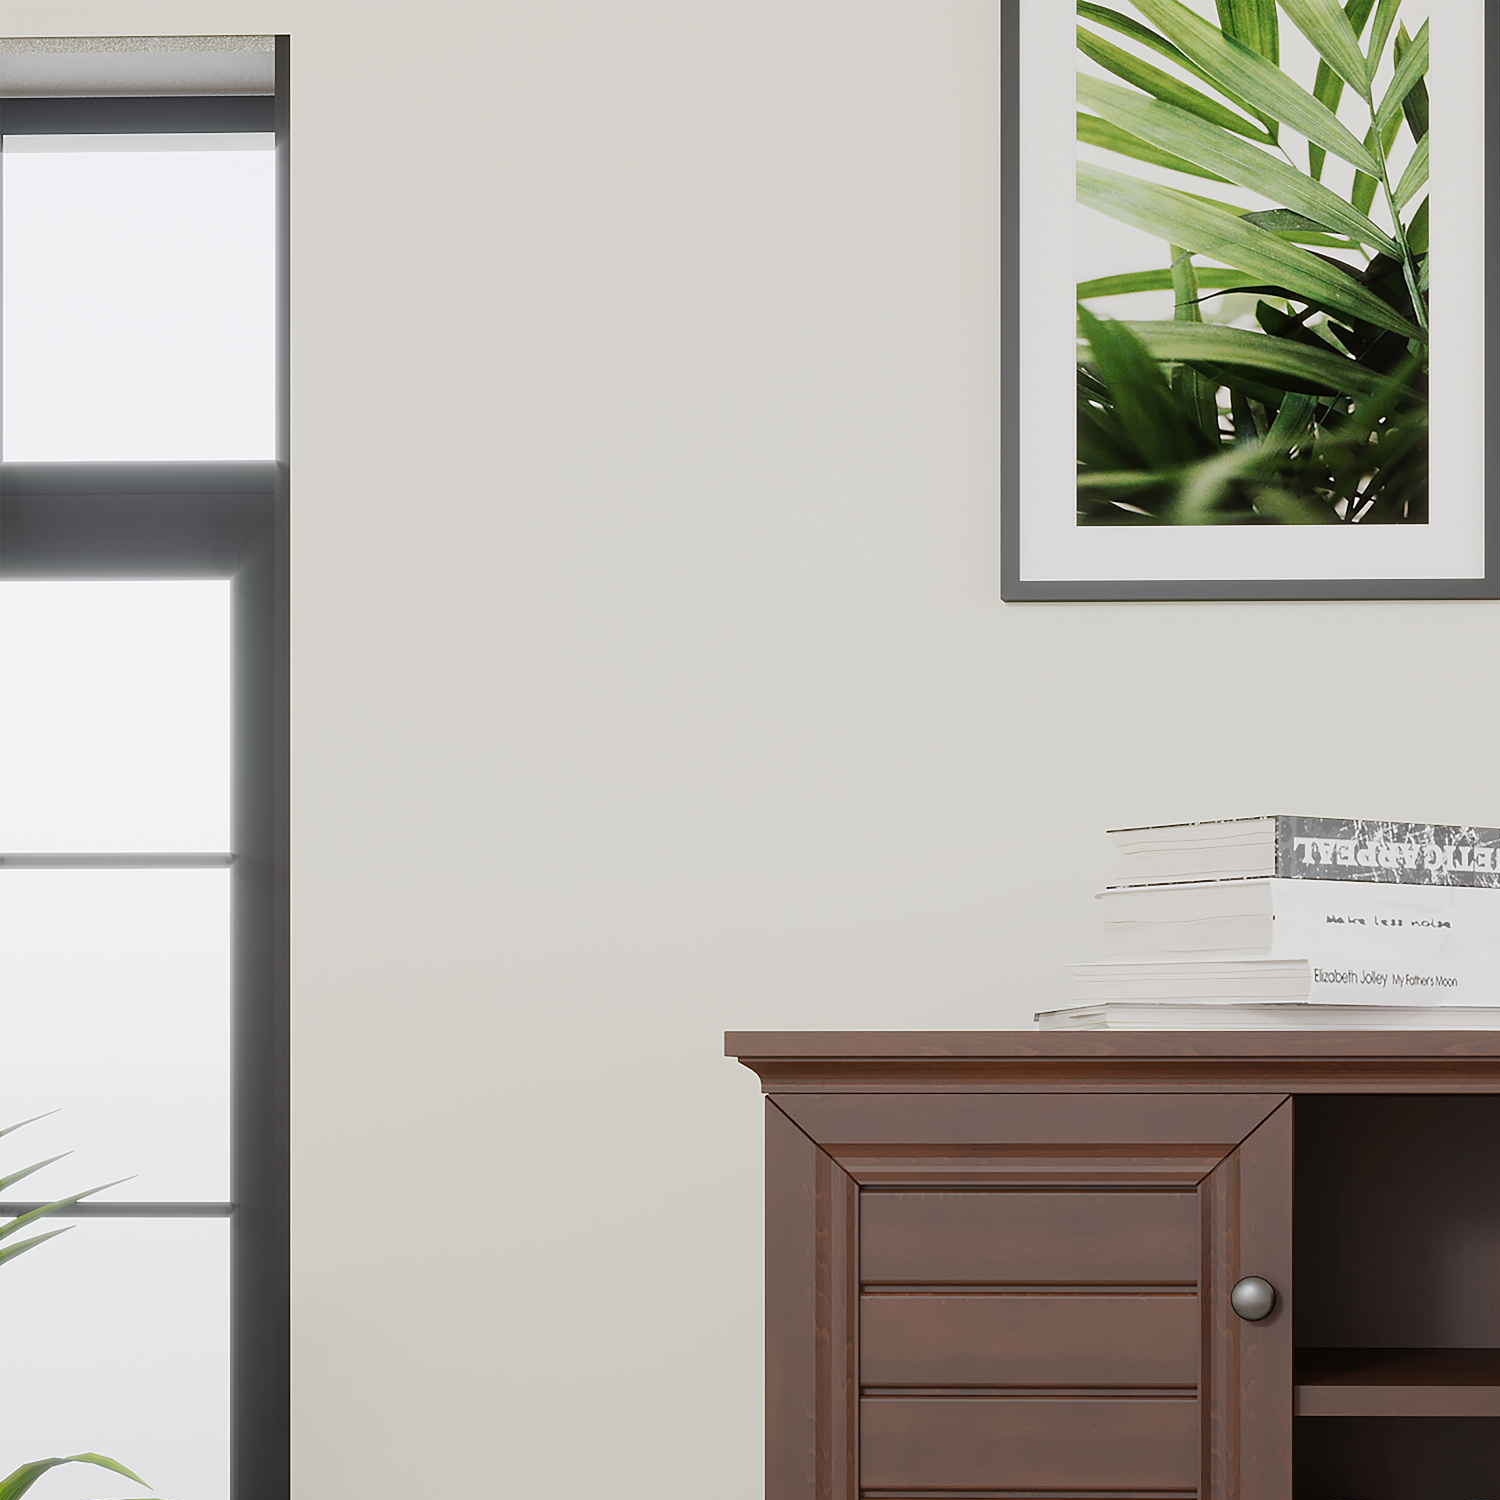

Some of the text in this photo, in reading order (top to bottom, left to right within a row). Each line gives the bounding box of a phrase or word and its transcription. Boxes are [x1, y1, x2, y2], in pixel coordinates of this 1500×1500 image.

[1374, 916, 1403, 926] less
[1411, 919, 1451, 928] noise
[1314, 968, 1458, 988] Elizabeth Jolley My Father's Moon
